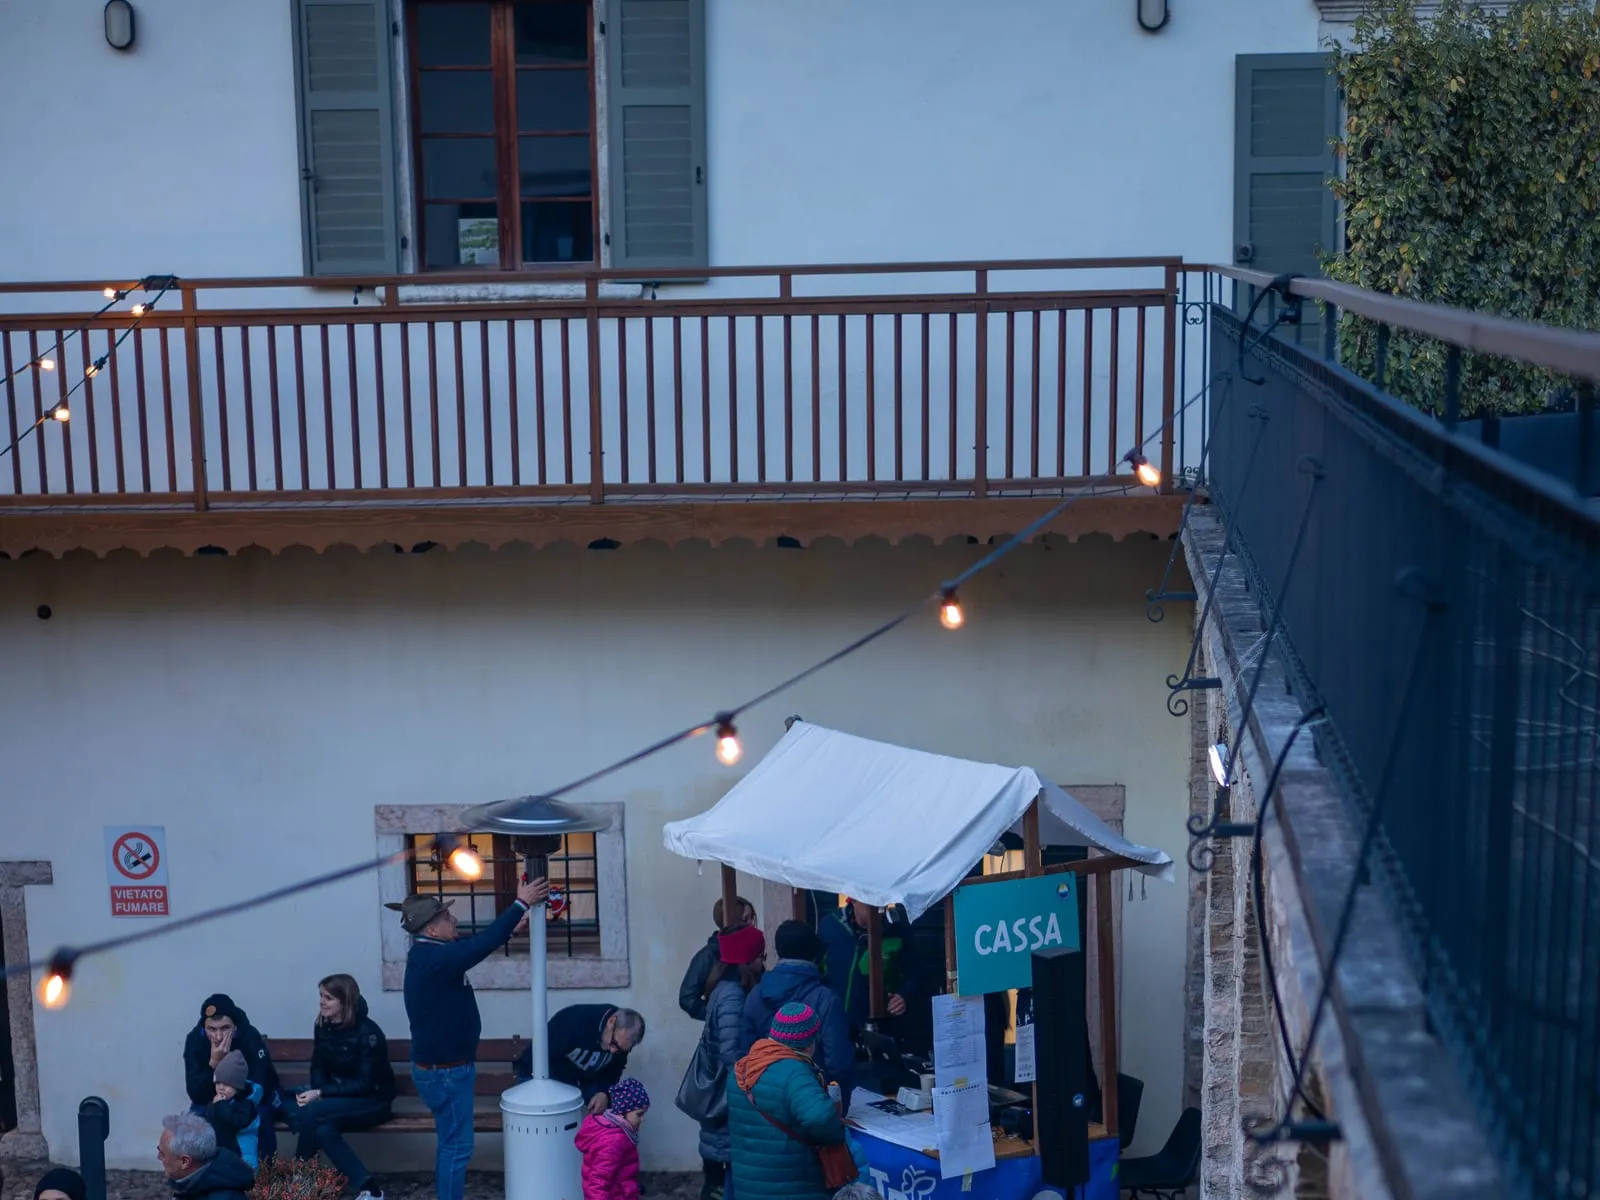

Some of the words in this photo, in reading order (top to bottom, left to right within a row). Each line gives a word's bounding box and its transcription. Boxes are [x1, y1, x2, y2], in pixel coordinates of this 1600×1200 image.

[114, 889, 163, 899] VIETATO
[115, 902, 165, 912] FUMARE
[974, 912, 1062, 955] CASSA
